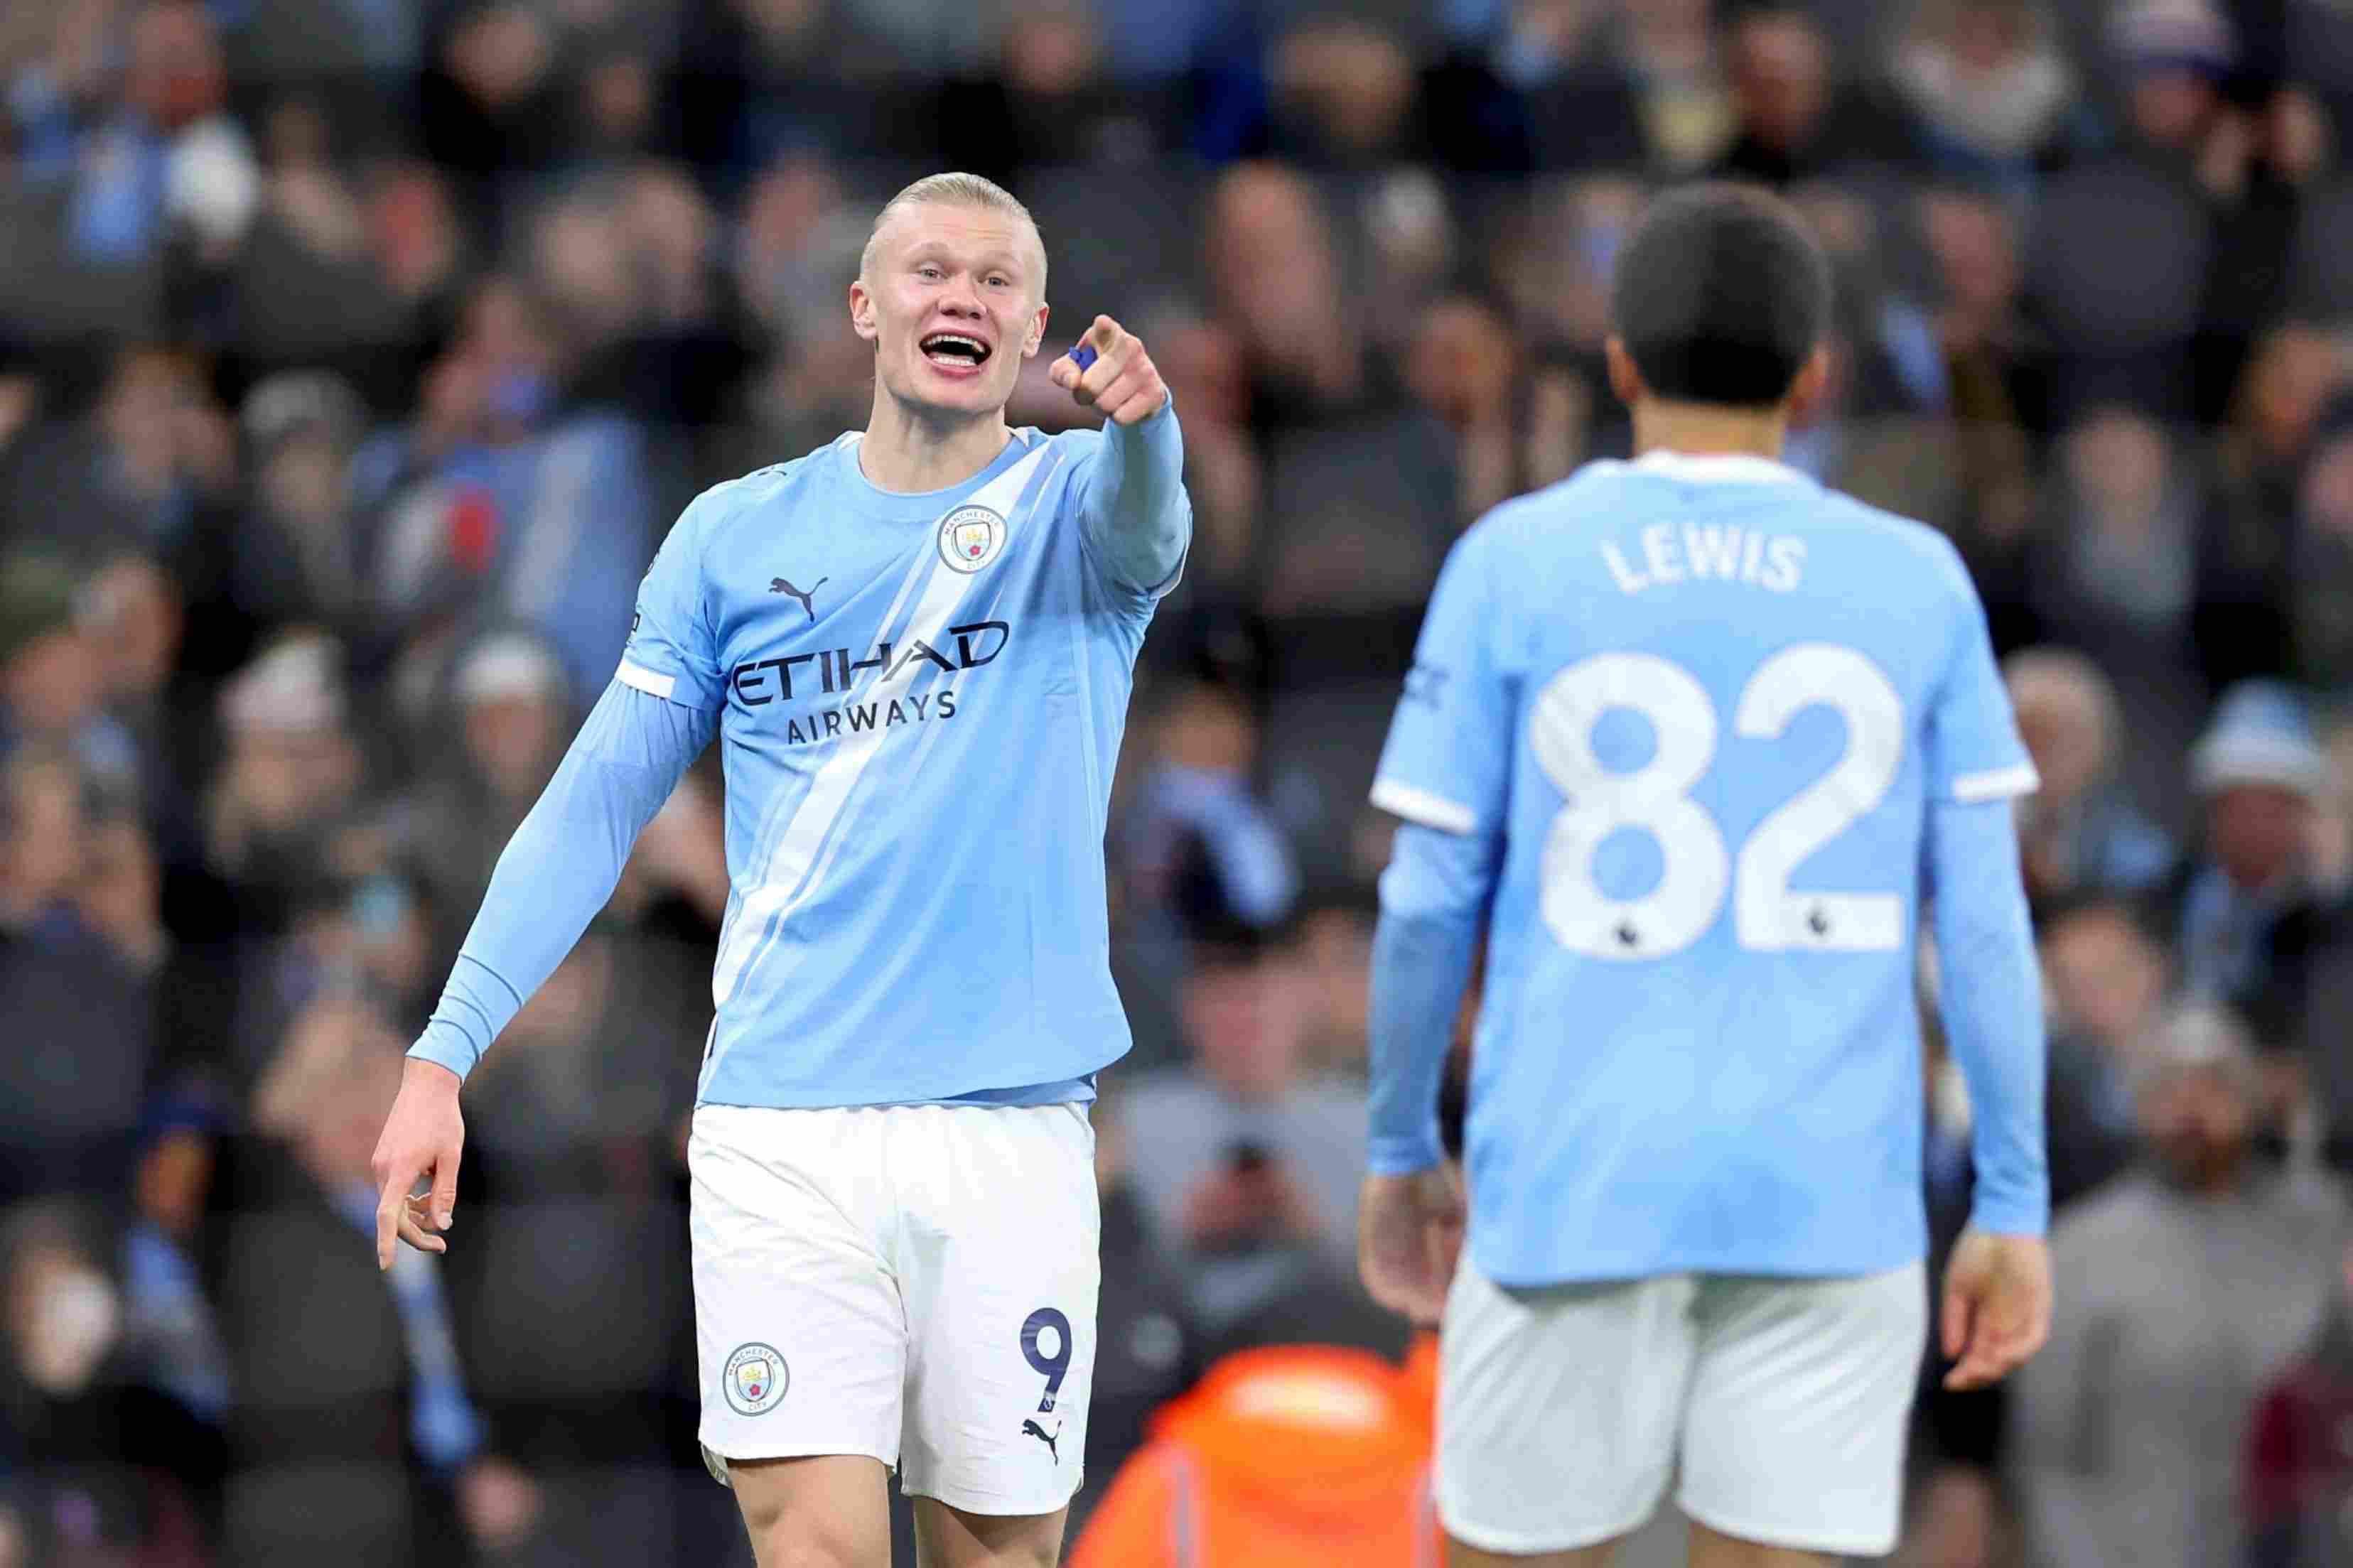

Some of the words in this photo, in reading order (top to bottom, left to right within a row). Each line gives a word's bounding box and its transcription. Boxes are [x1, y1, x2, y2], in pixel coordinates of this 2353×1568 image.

[1600, 523, 1807, 593] LEWIS
[733, 621, 1009, 706] ETIHAD
[787, 691, 956, 745] AIRWAYS
[1531, 642, 1905, 961] 82
[728, 1348, 779, 1376] MANCHESTER
[1020, 1307, 1072, 1412] 9
